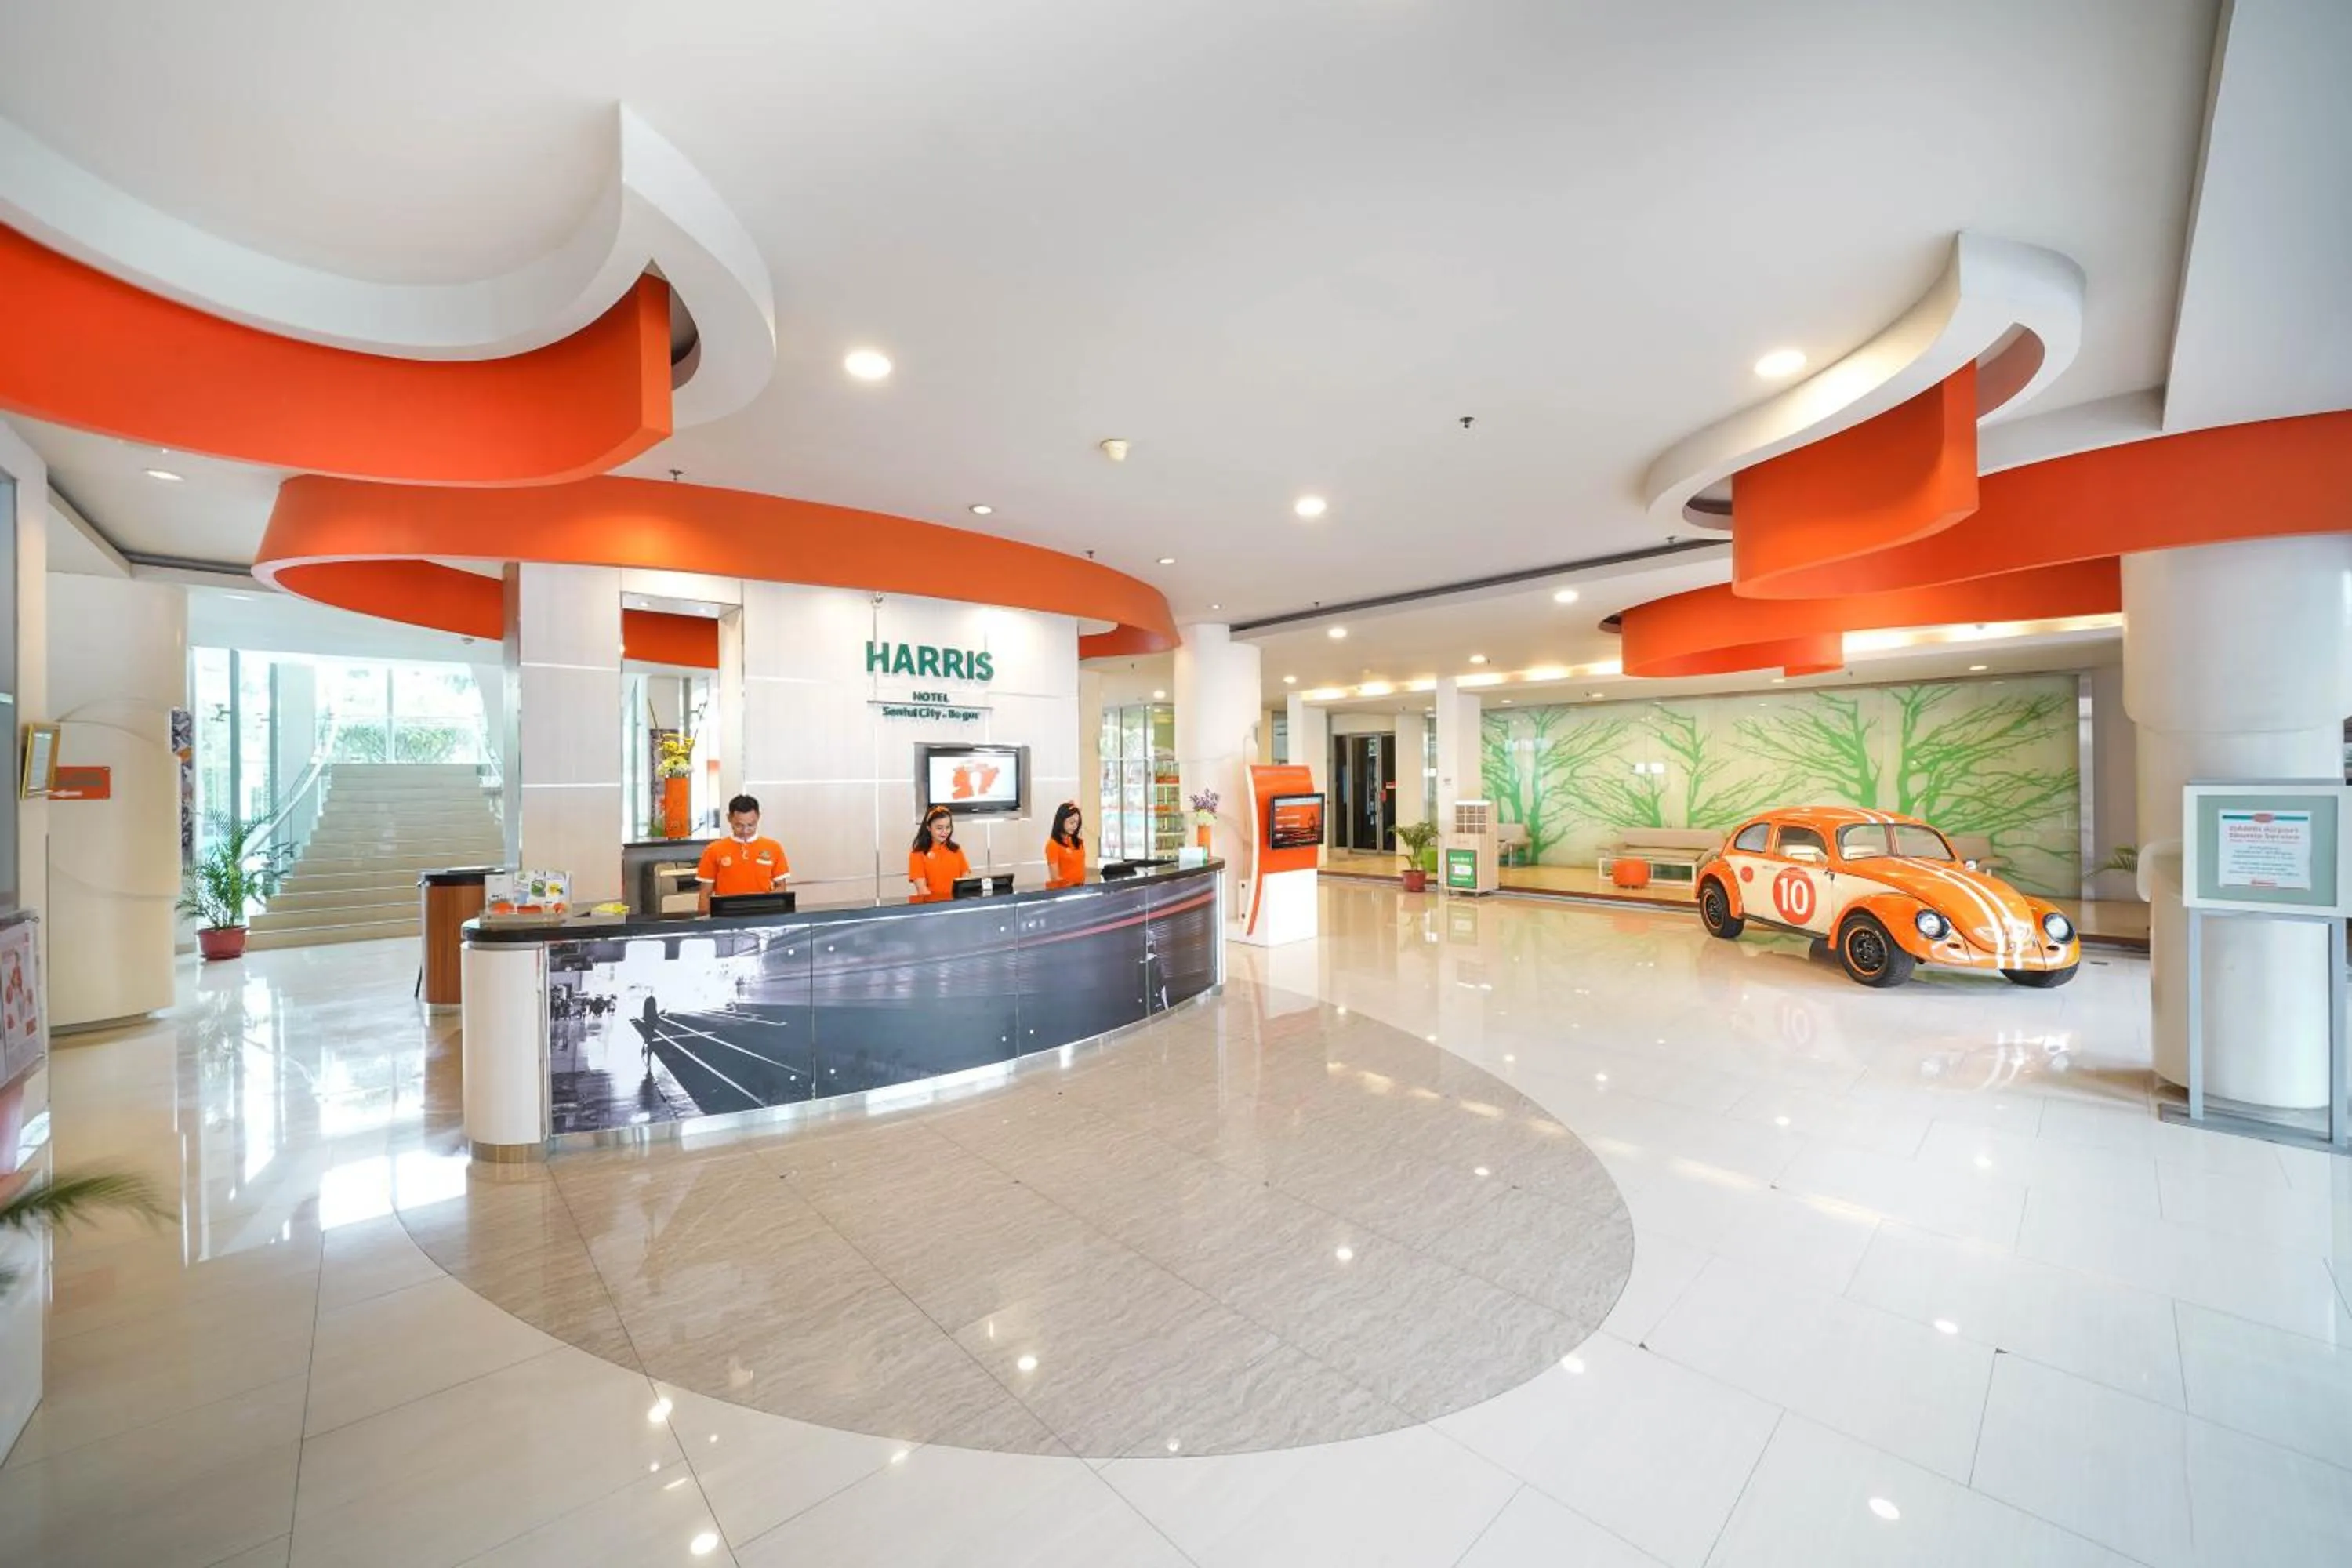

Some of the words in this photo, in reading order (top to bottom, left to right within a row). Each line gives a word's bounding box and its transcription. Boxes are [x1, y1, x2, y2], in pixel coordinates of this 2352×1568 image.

[866, 641, 995, 681] HARRIS
[912, 691, 950, 703] HOTEL
[918, 708, 942, 720] City
[1779, 877, 1809, 916] 10
